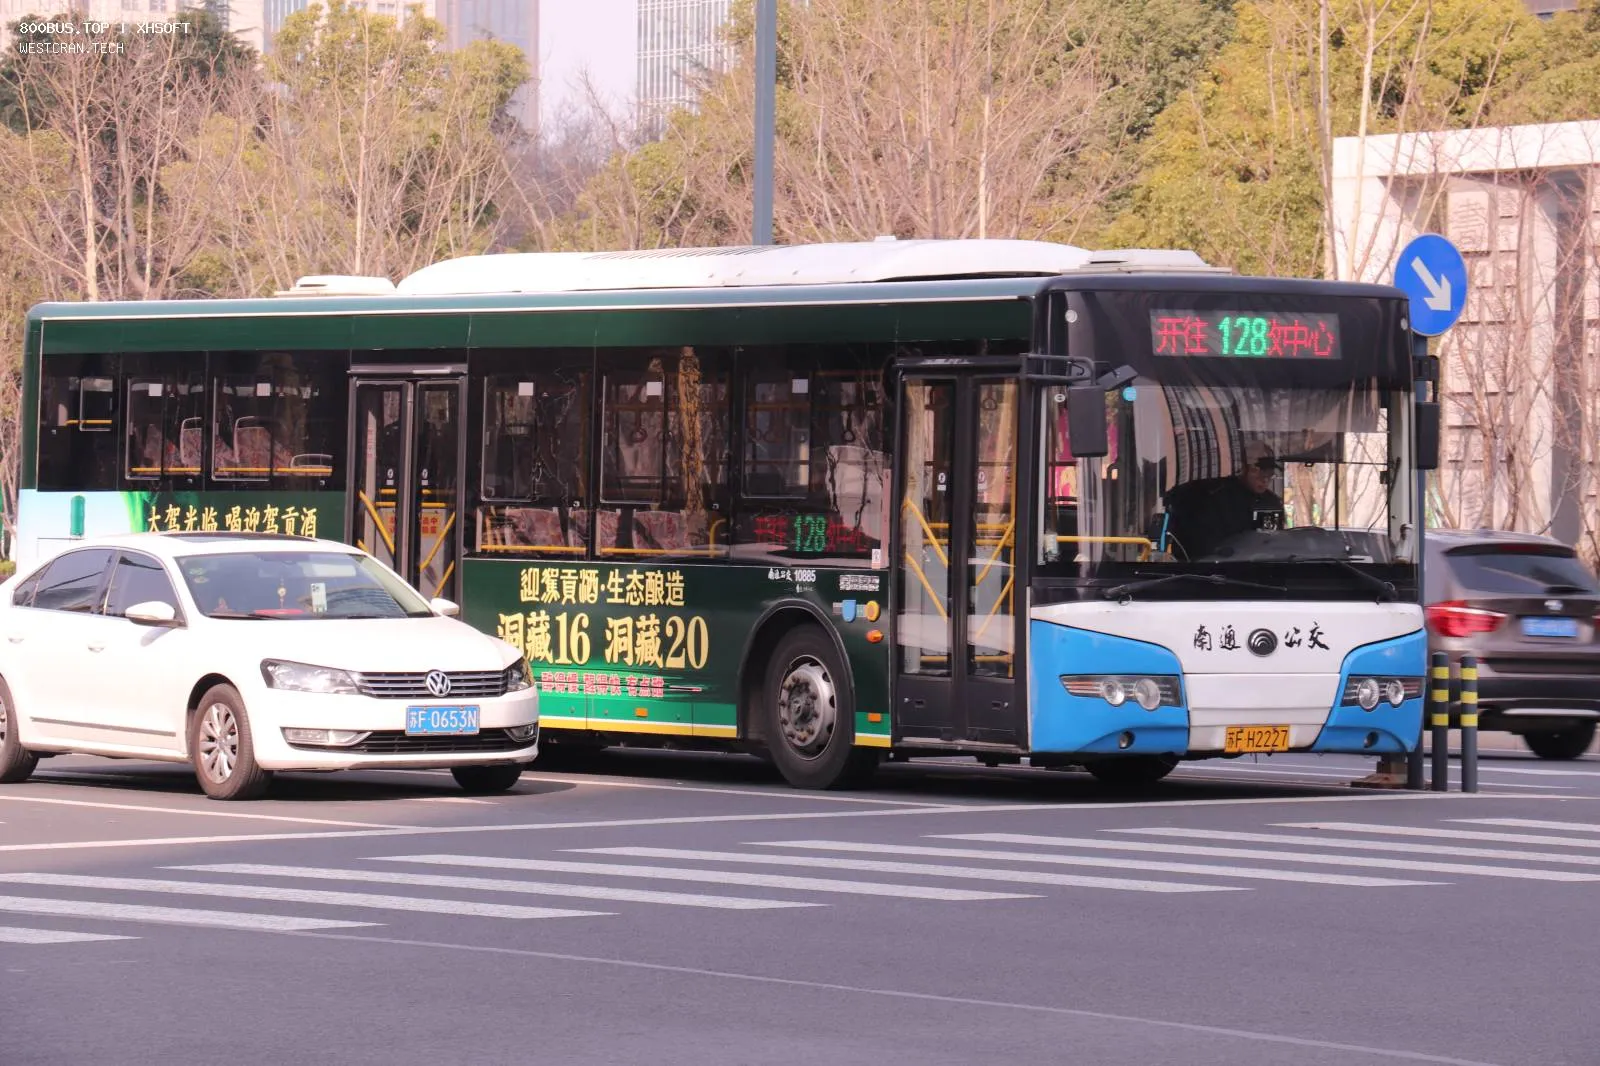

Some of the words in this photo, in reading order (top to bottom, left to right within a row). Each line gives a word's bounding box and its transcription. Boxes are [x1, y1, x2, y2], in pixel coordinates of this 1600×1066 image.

[1217, 316, 1268, 355] 128
[794, 569, 817, 583] 10885
[605, 613, 709, 670] 洞藏20
